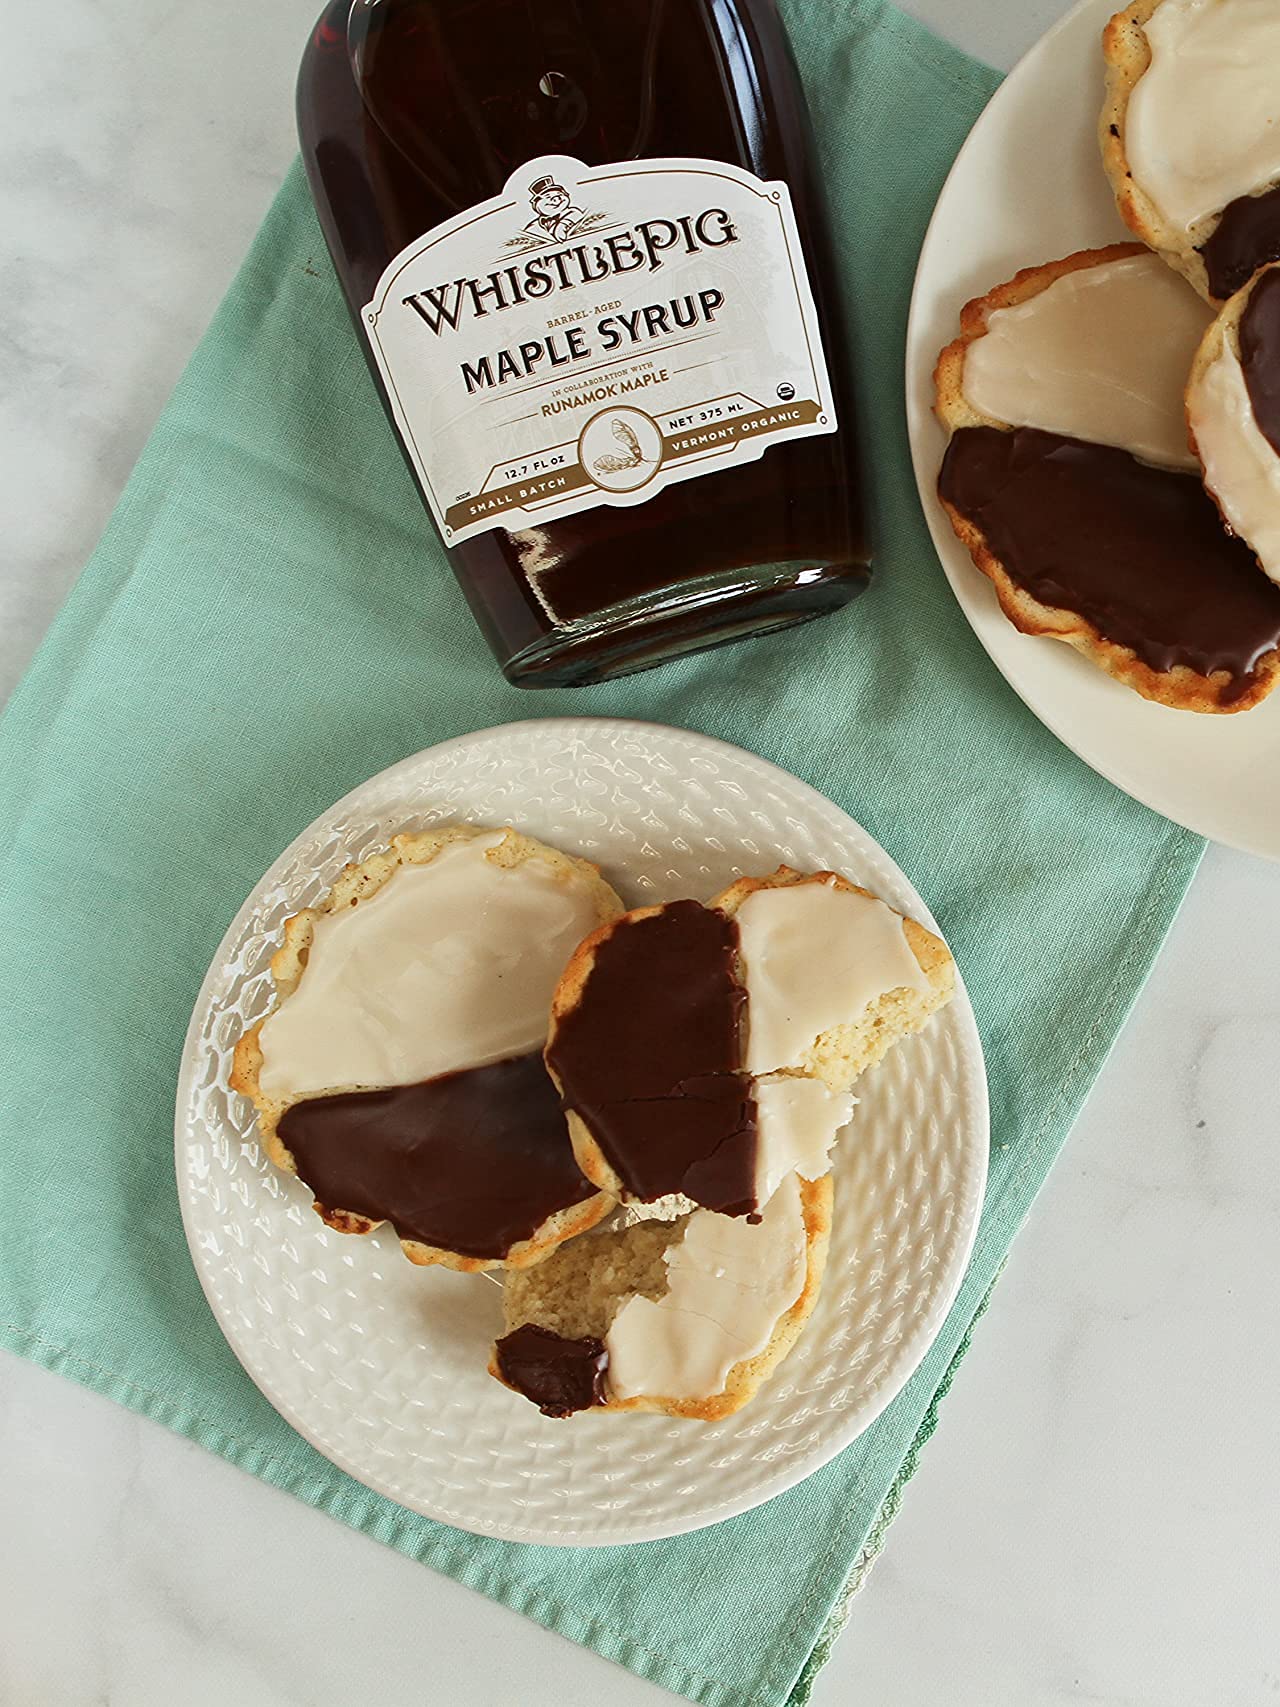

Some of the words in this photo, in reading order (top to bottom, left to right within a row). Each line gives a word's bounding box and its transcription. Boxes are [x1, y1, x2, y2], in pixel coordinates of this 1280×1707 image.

[402, 207, 740, 337] WHISTLEPIG
[546, 299, 623, 329] BARREL-AGED
[460, 327, 592, 395] MAPLE
[597, 288, 725, 352] SYRUP
[552, 389, 562, 398] IN
[563, 368, 628, 394] COLLABORATION
[630, 361, 654, 373] WITH
[620, 369, 670, 393] MAPLE
[669, 415, 694, 430] NET
[699, 407, 723, 421] 375
[727, 403, 744, 413] ML
[671, 426, 736, 452] VERMONT
[741, 410, 800, 432] ORGANIC
[504, 466, 528, 480] 12.7
[533, 460, 549, 471] FL
[469, 495, 513, 516] SMALL
[519, 477, 566, 498] BATCH
